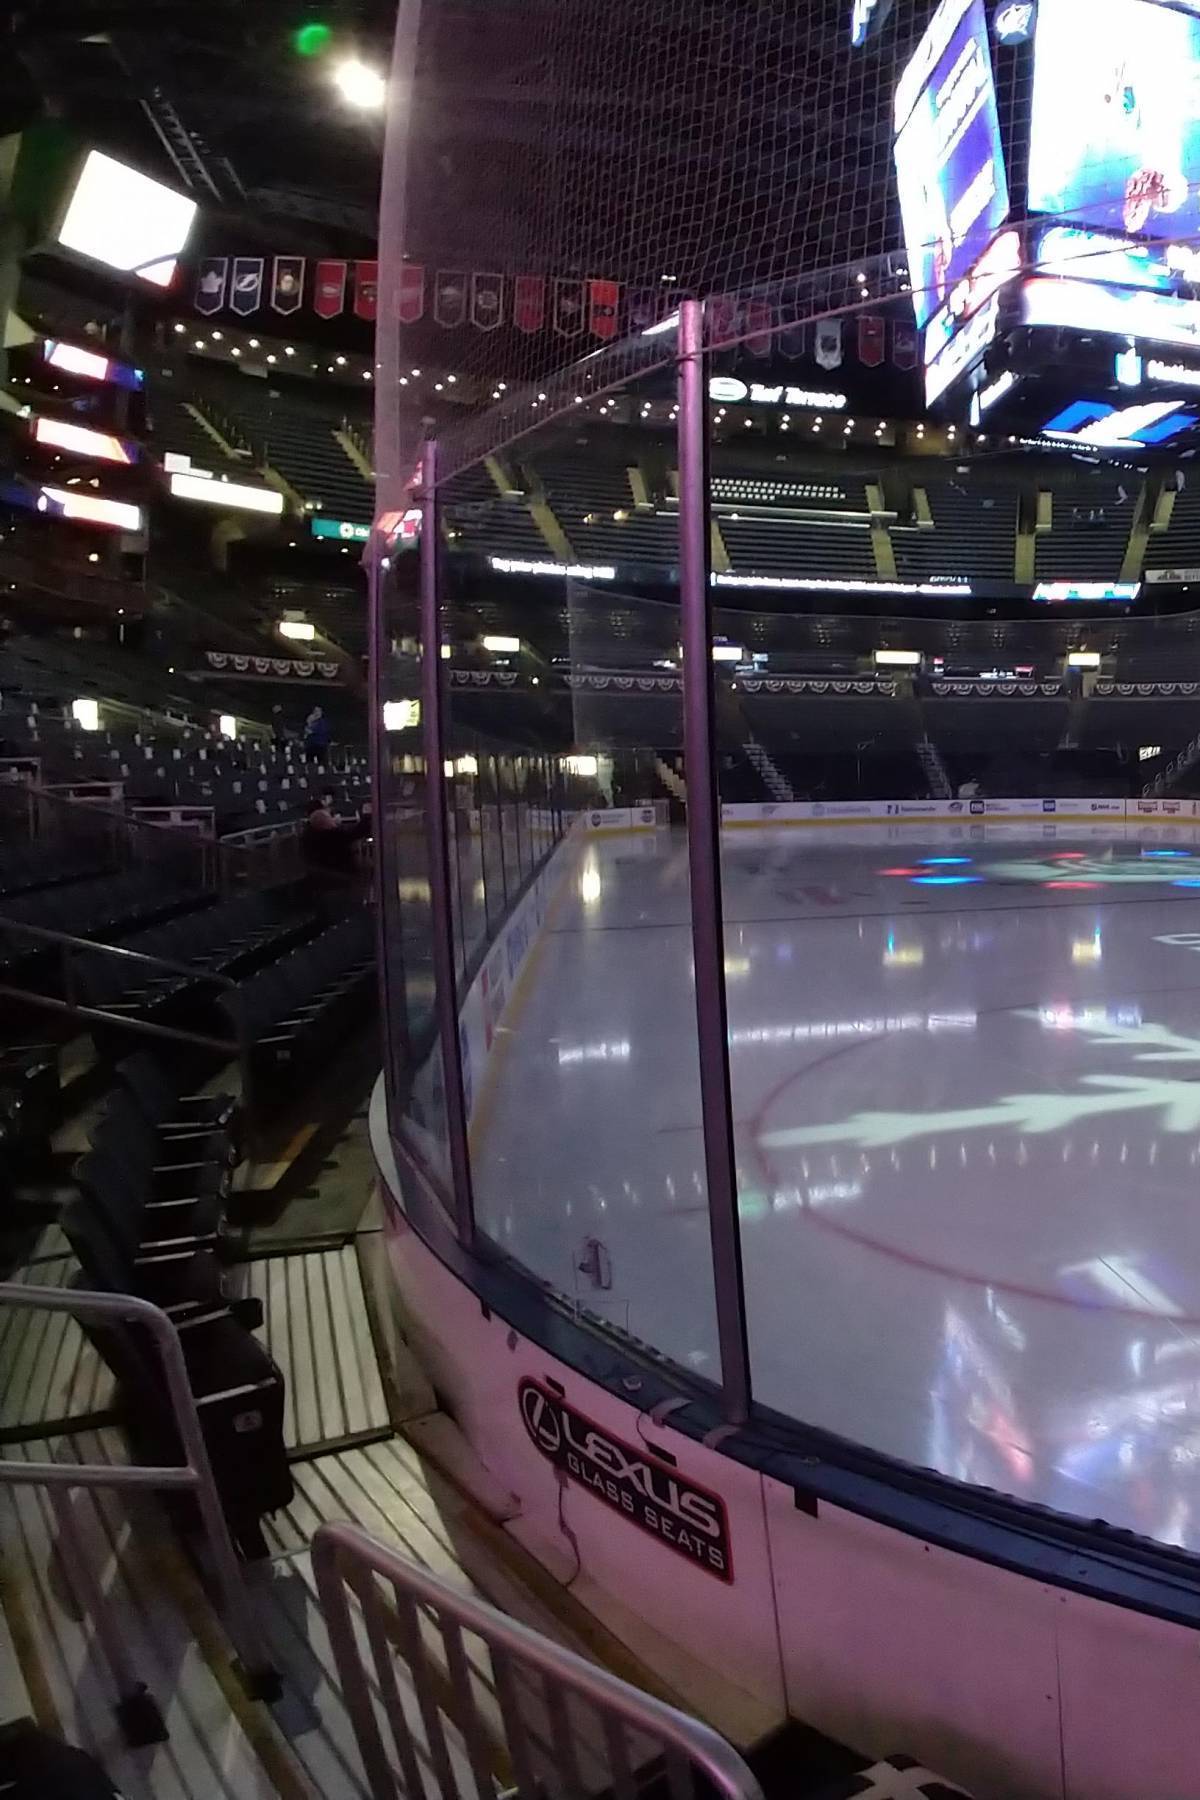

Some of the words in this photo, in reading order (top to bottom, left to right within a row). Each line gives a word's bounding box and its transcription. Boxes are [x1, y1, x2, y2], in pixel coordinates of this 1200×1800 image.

[562, 1411, 721, 1539] LEXUS
[566, 1452, 634, 1514] GLASS
[644, 1506, 725, 1570] SEATS
